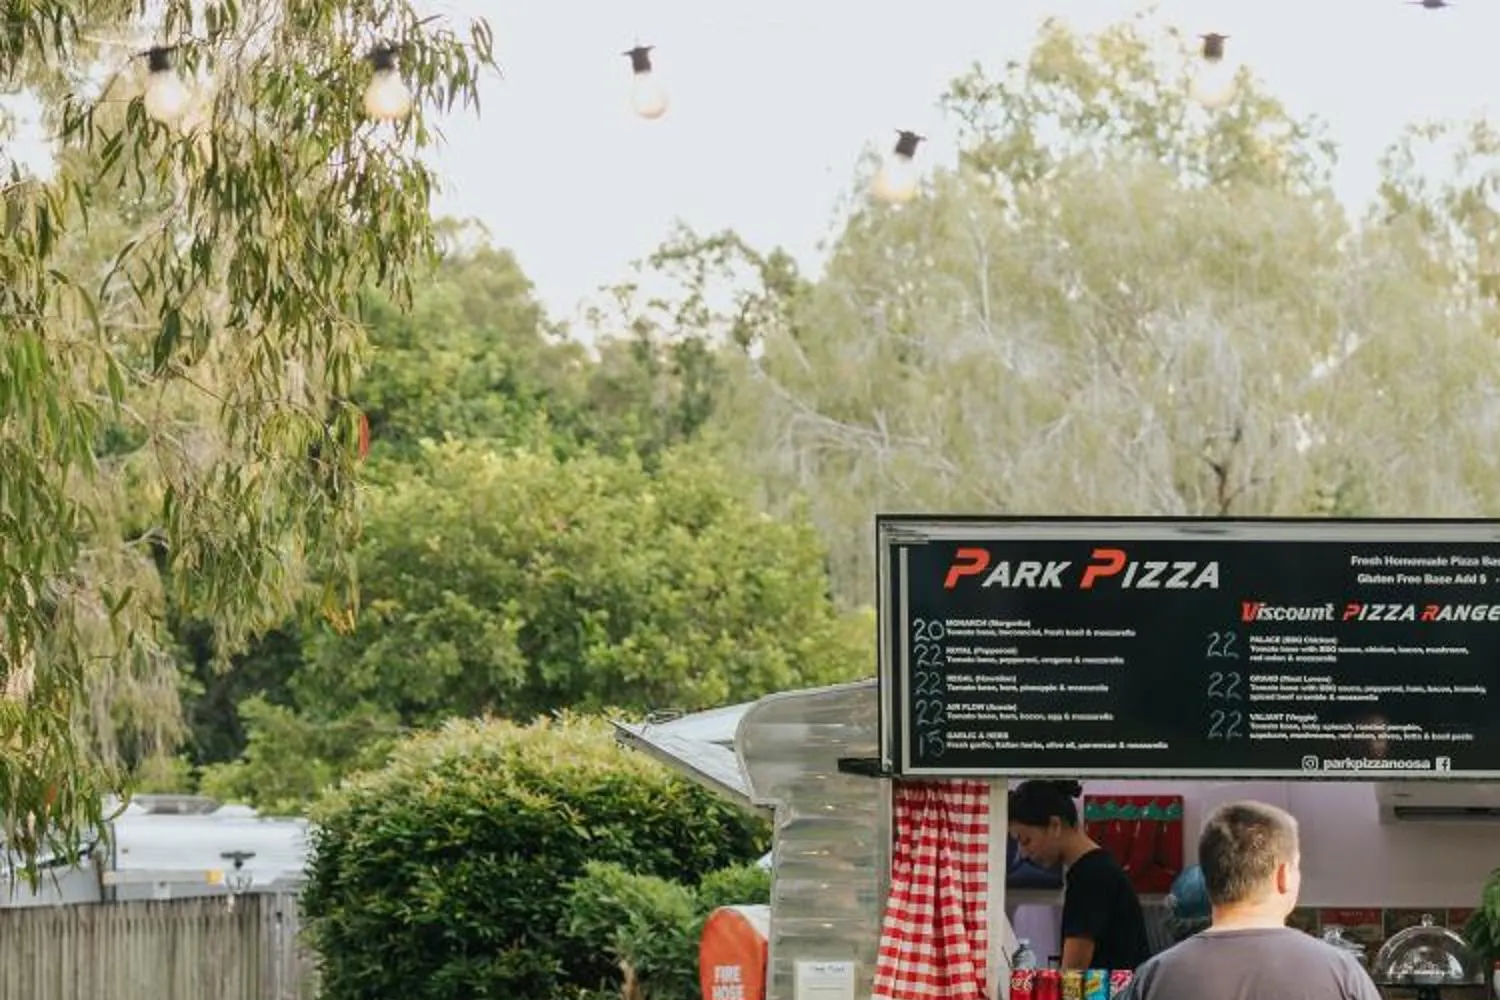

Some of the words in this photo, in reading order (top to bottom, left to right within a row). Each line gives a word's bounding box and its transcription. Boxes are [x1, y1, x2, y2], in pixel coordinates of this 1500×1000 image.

[944, 548, 1071, 589] PARK
[1079, 548, 1219, 589] PIZZA
[1350, 556, 1382, 565] Fresh
[1384, 557, 1448, 566] Homemade
[1450, 556, 1479, 566] Pizza
[1357, 574, 1394, 582] Gluten
[1423, 575, 1452, 584] Base
[1454, 575, 1477, 583] Add
[1241, 602, 1335, 621] Viscount
[1343, 603, 1416, 622] PIZZA
[913, 618, 945, 642] 20
[913, 645, 944, 667] 22
[1206, 631, 1240, 659] 22
[914, 672, 944, 696] 22
[1207, 672, 1242, 700] 22
[915, 699, 946, 726] 22
[1323, 758, 1430, 771] parkpizzanoosa
